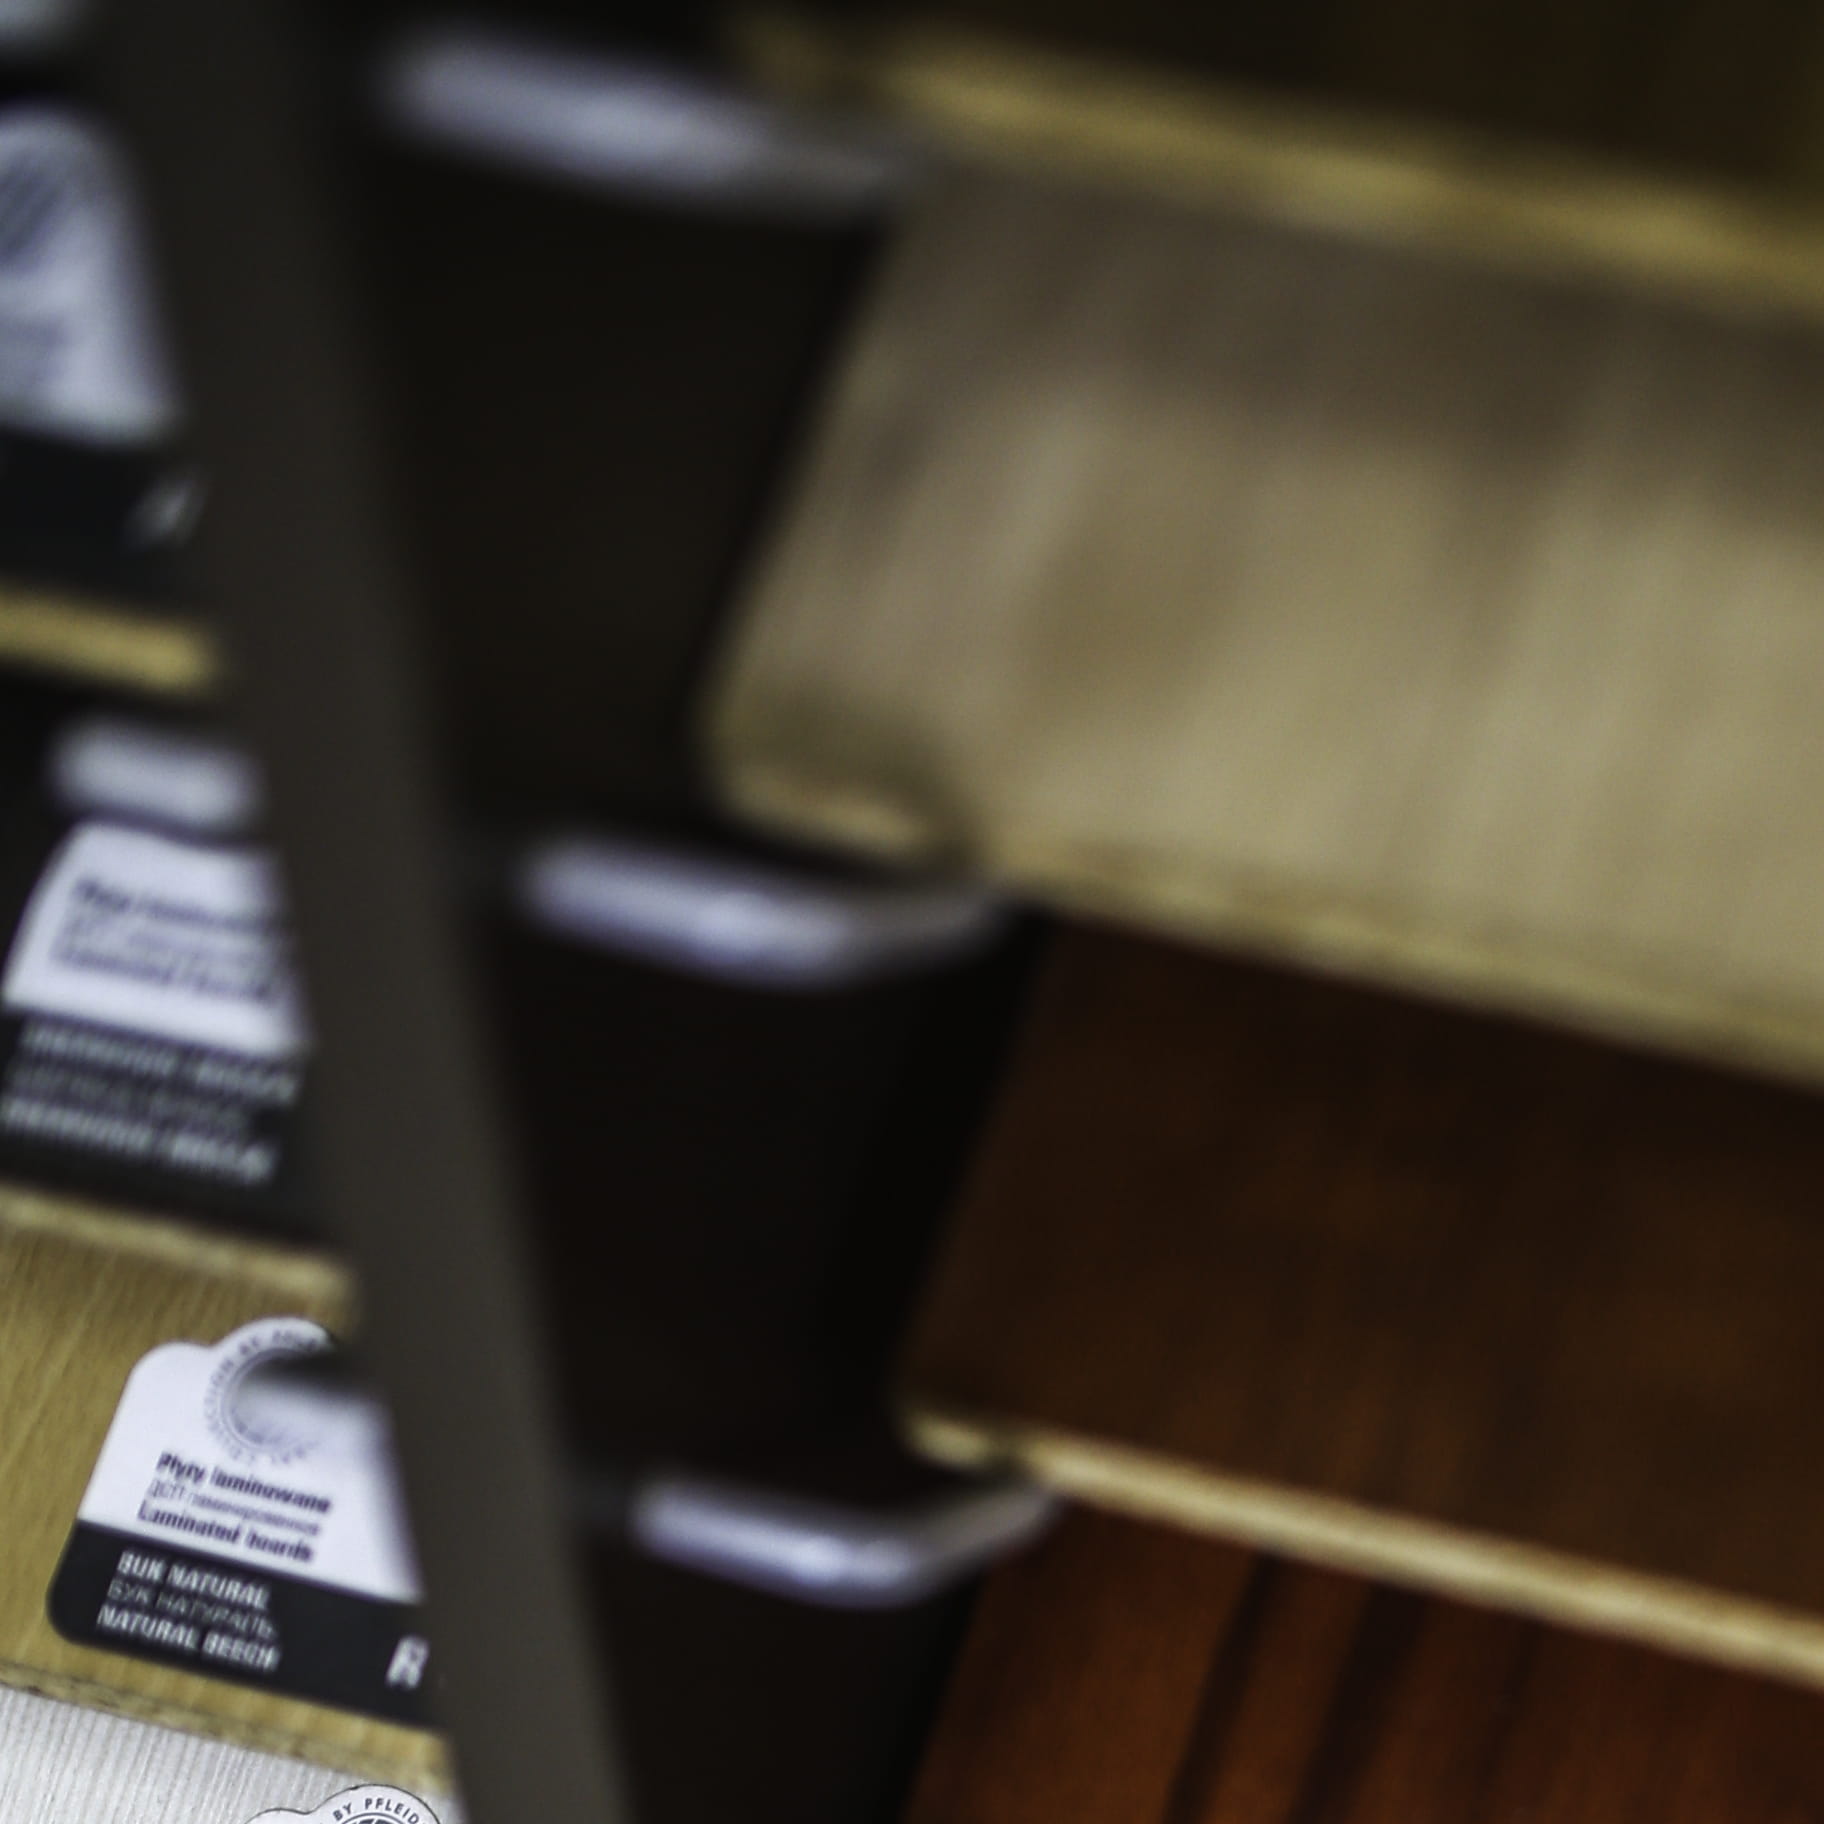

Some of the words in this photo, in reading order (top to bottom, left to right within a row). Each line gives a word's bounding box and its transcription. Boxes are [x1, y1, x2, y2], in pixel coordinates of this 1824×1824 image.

[167, 1564, 270, 1611] NATURAL
[97, 1604, 198, 1650] NATURAL
[333, 1803, 352, 1821] BY
